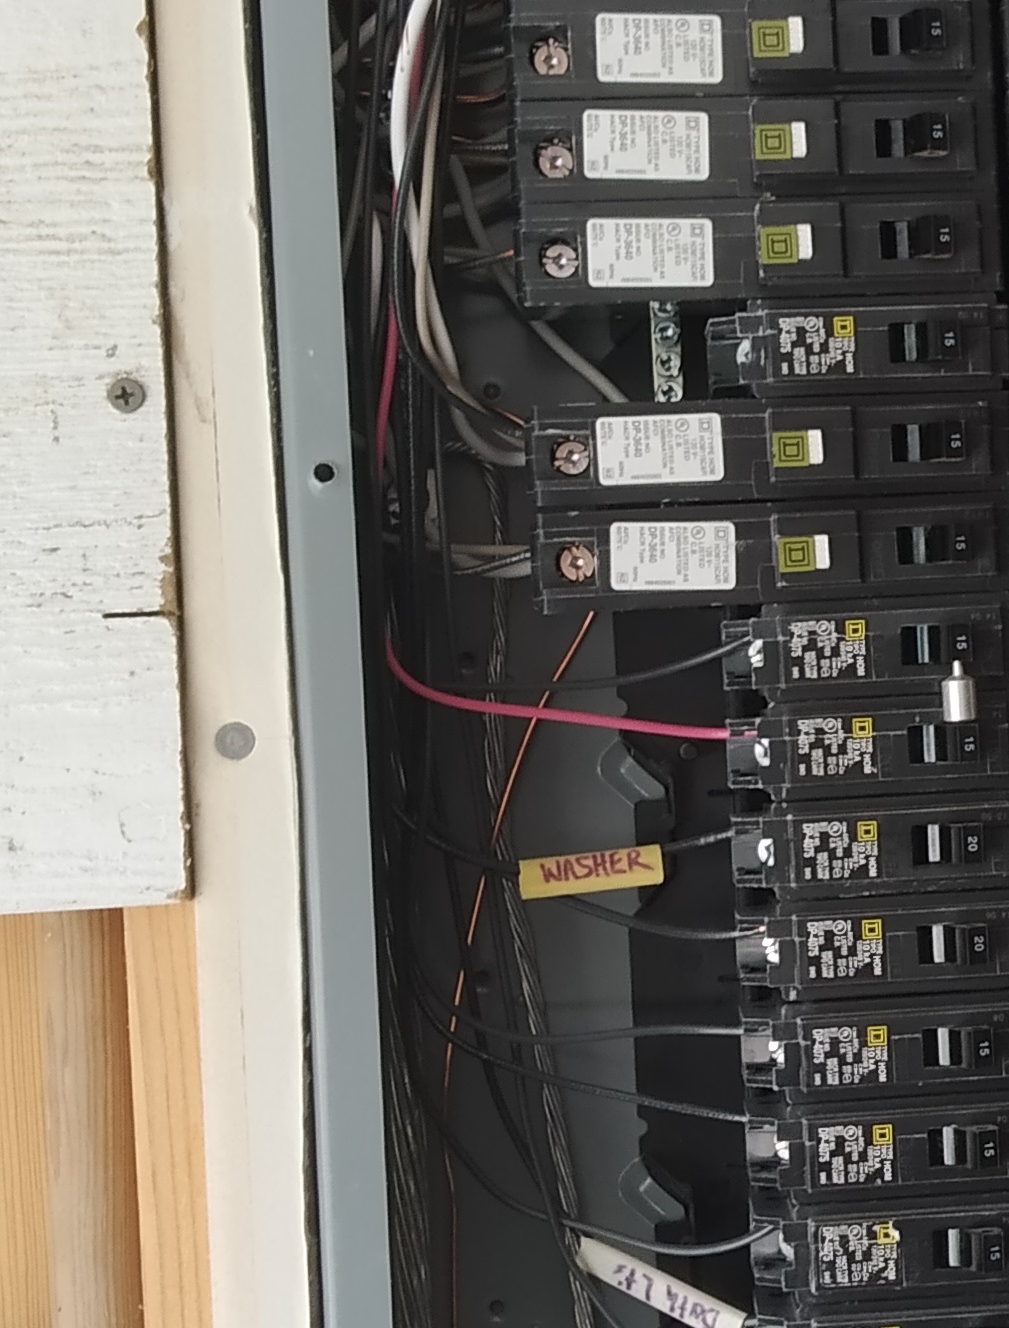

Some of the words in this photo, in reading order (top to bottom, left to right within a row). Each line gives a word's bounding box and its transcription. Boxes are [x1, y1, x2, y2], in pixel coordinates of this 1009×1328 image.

[932, 21, 942, 35] 15
[932, 125, 942, 139] 15
[940, 227, 950, 241] 15
[944, 331, 954, 347] 15
[950, 433, 962, 447] 15
[956, 535, 966, 549] 15
[956, 635, 968, 649] 15
[964, 737, 974, 751] 15
[968, 837, 978, 851] 20
[540, 849, 655, 884] WASHER
[974, 935, 984, 951] 20
[980, 1041, 990, 1055] 15
[984, 1143, 994, 1157] 15
[990, 1247, 1000, 1261] 15
